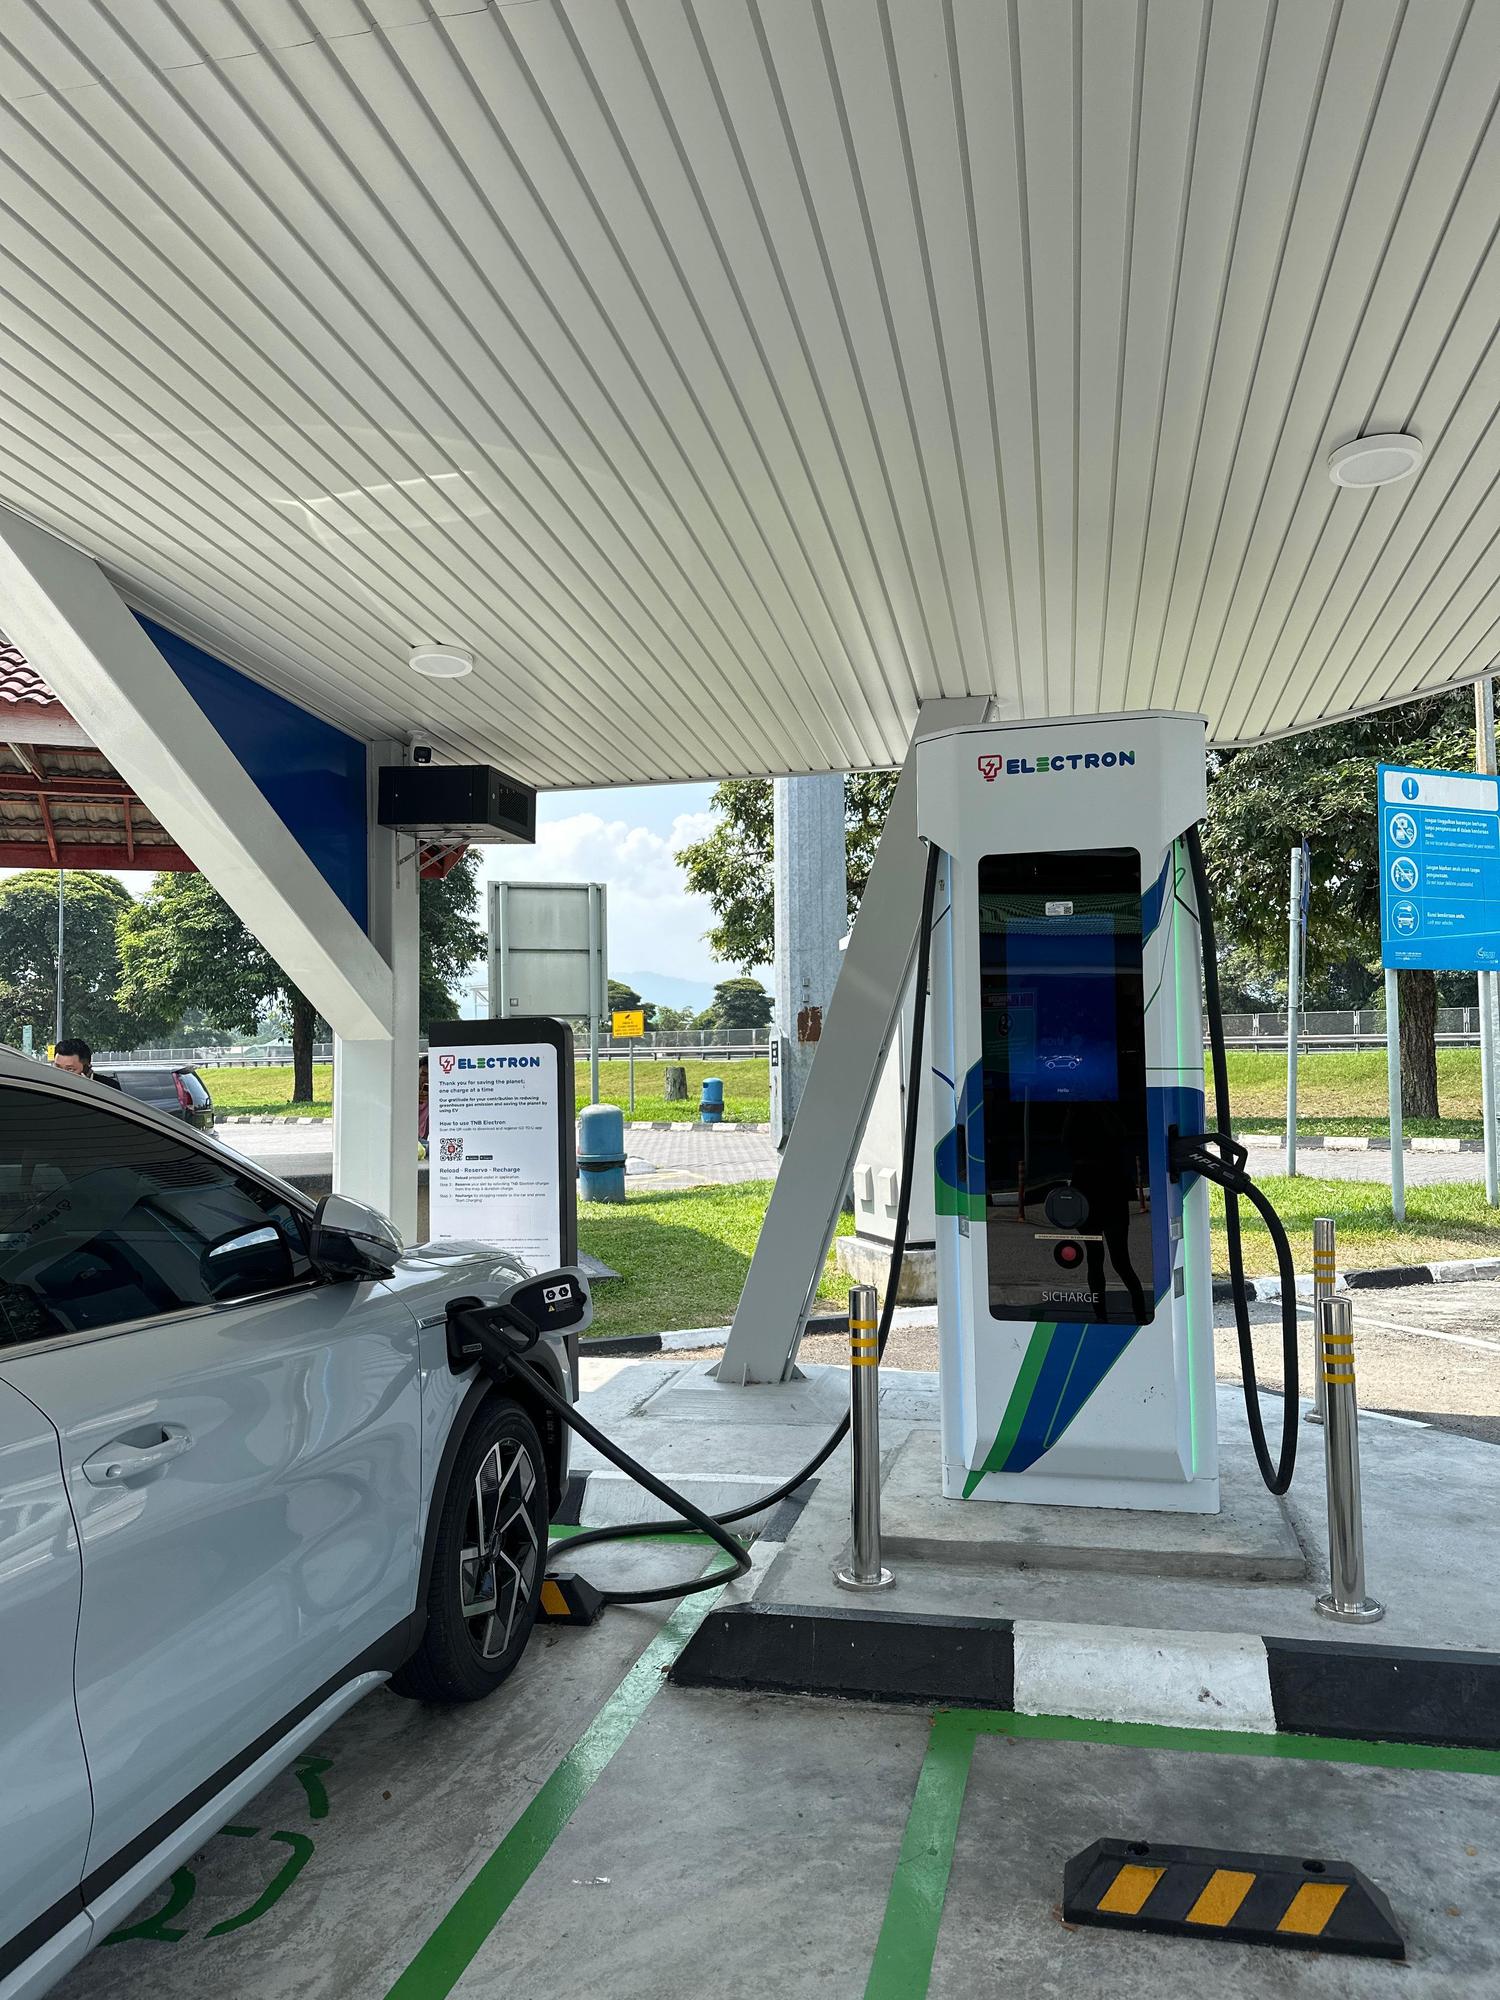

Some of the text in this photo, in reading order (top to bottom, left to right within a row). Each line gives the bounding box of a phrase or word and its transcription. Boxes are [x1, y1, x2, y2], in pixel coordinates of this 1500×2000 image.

[1006, 750, 1135, 775] ELECTRON
[457, 1056, 540, 1070] ELECTRON
[1042, 1290, 1099, 1303] SICHARGE
